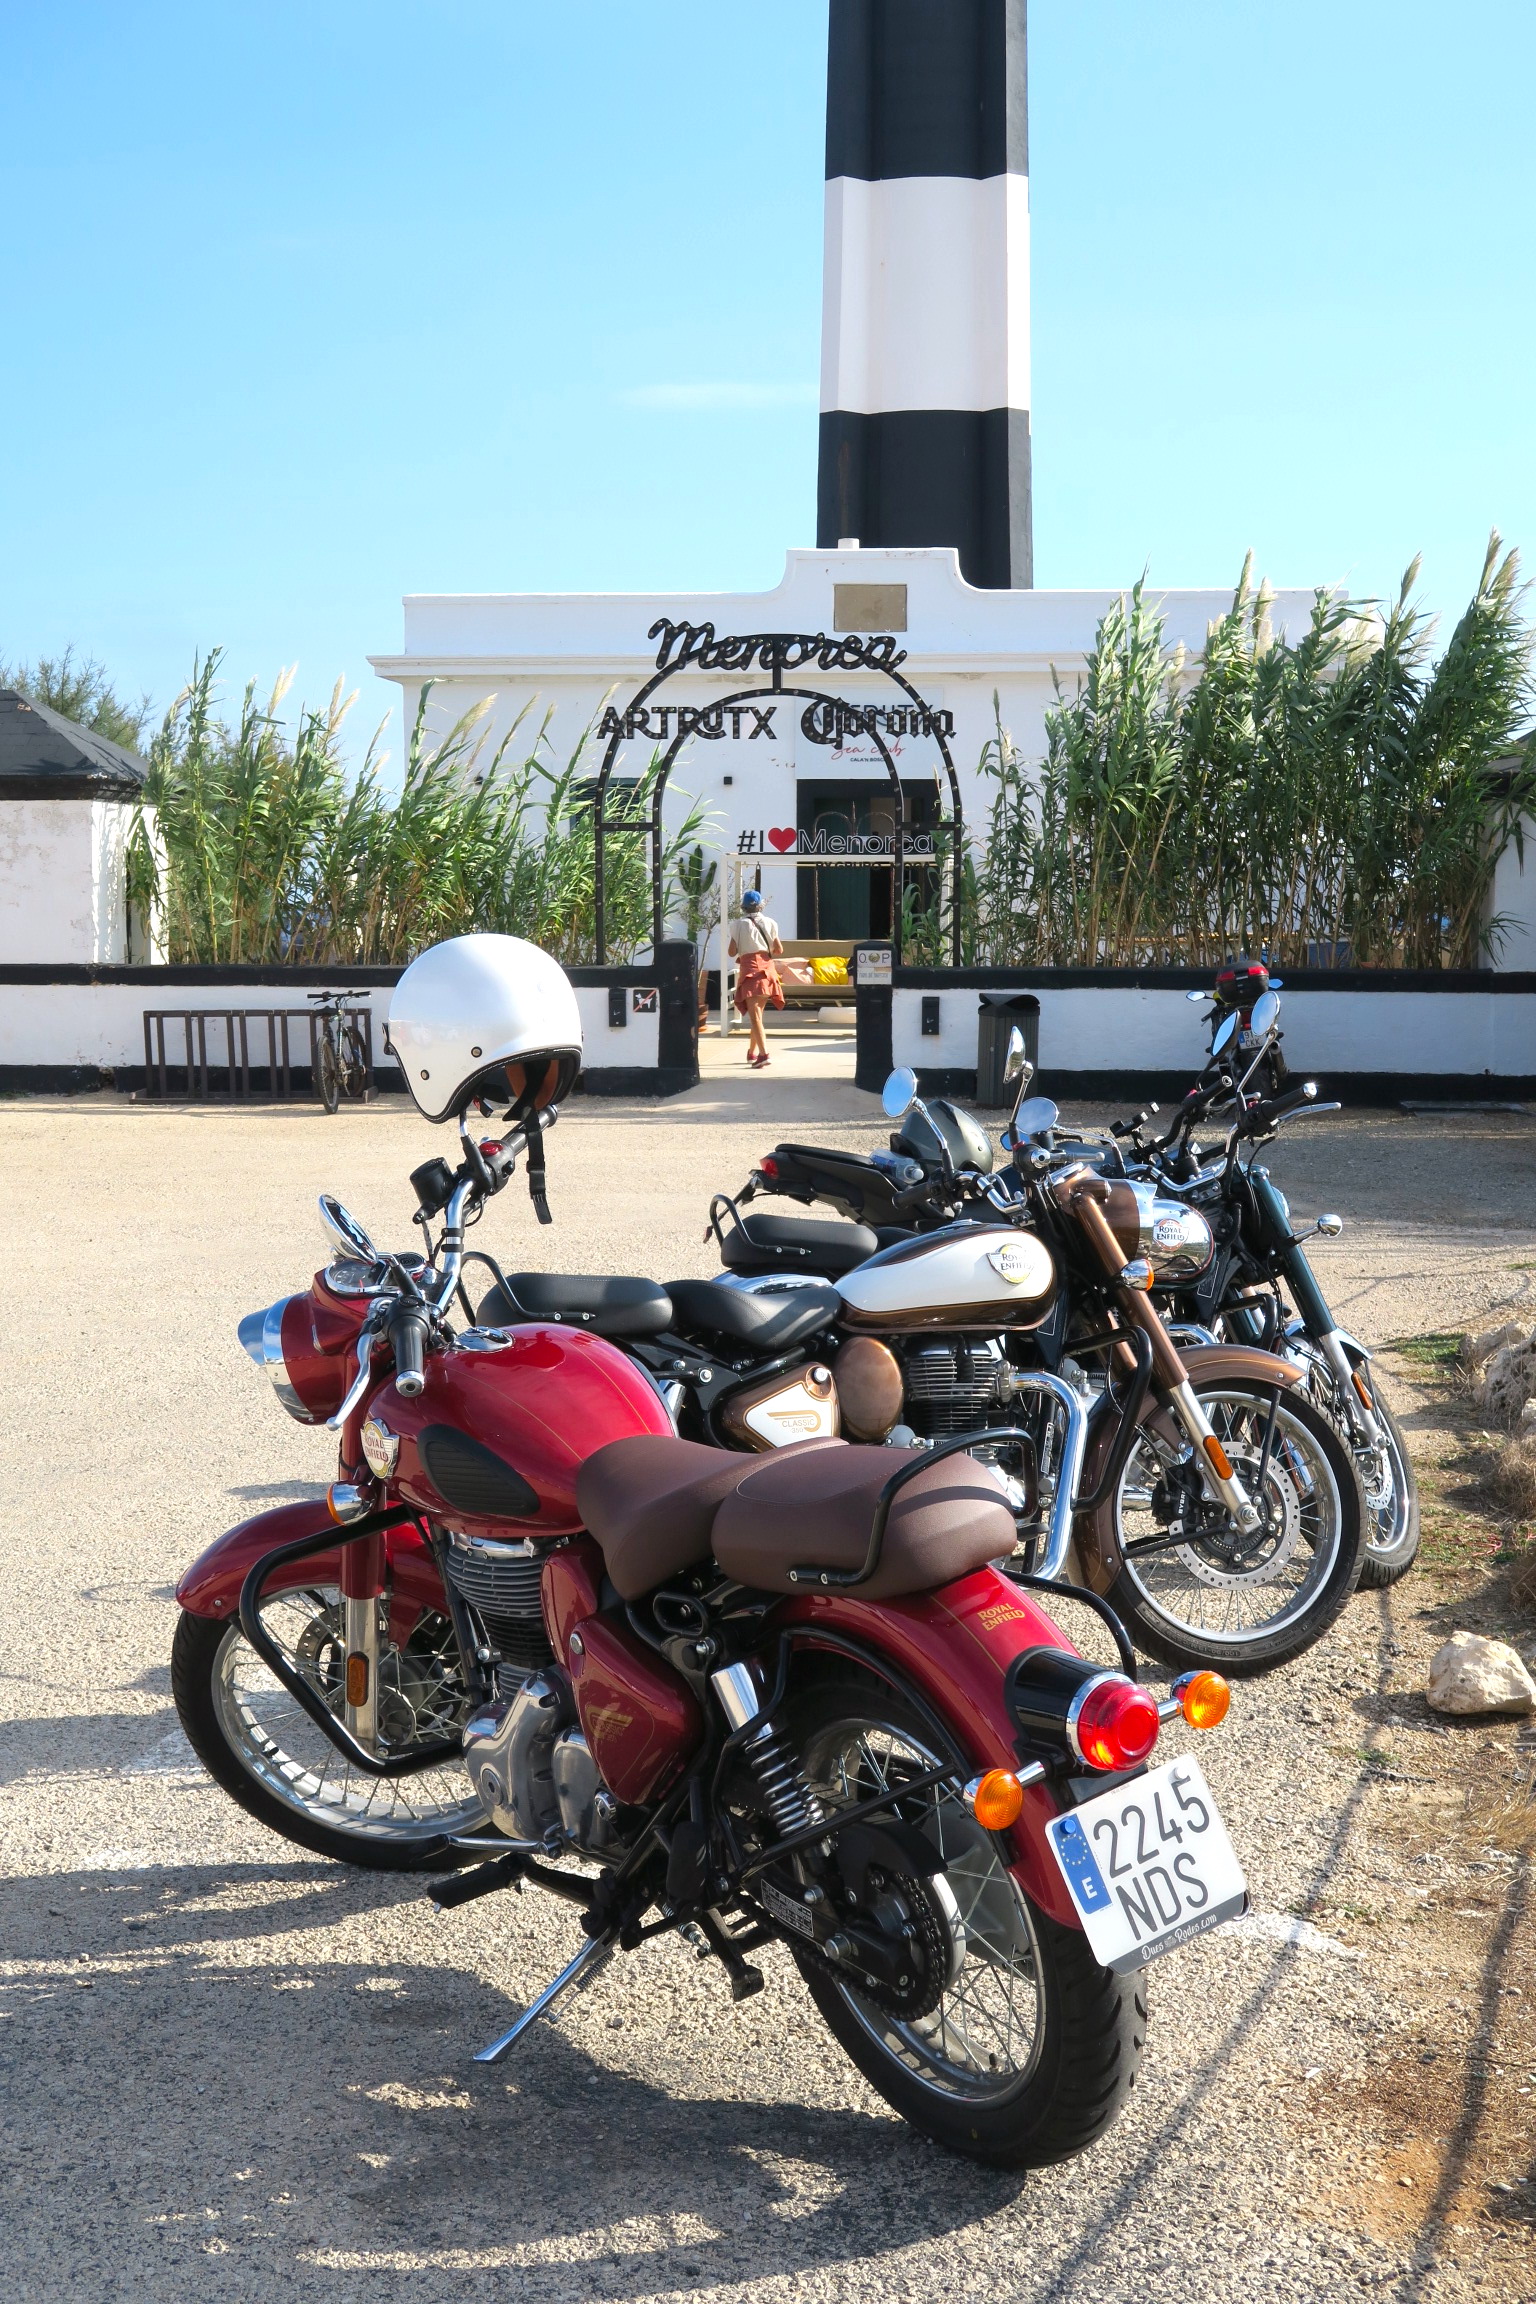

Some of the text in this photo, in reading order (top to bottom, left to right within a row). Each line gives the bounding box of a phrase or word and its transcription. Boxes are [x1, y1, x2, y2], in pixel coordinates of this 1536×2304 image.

[648, 618, 907, 670] Menorca
[597, 706, 777, 740] ARTRUTX
[801, 697, 957, 750] Corona
[798, 828, 934, 854] Menorca
[1159, 1225, 1182, 1233] ROYAL
[782, 1419, 815, 1428] CLASSIC
[977, 1603, 1014, 1620] ROYAL
[982, 1609, 1025, 1631] ENFIELD
[1093, 1775, 1210, 1879] 2245
[1081, 1876, 1098, 1899] E
[1115, 1852, 1209, 1941] NDS
[1141, 1942, 1164, 1960] Dues
